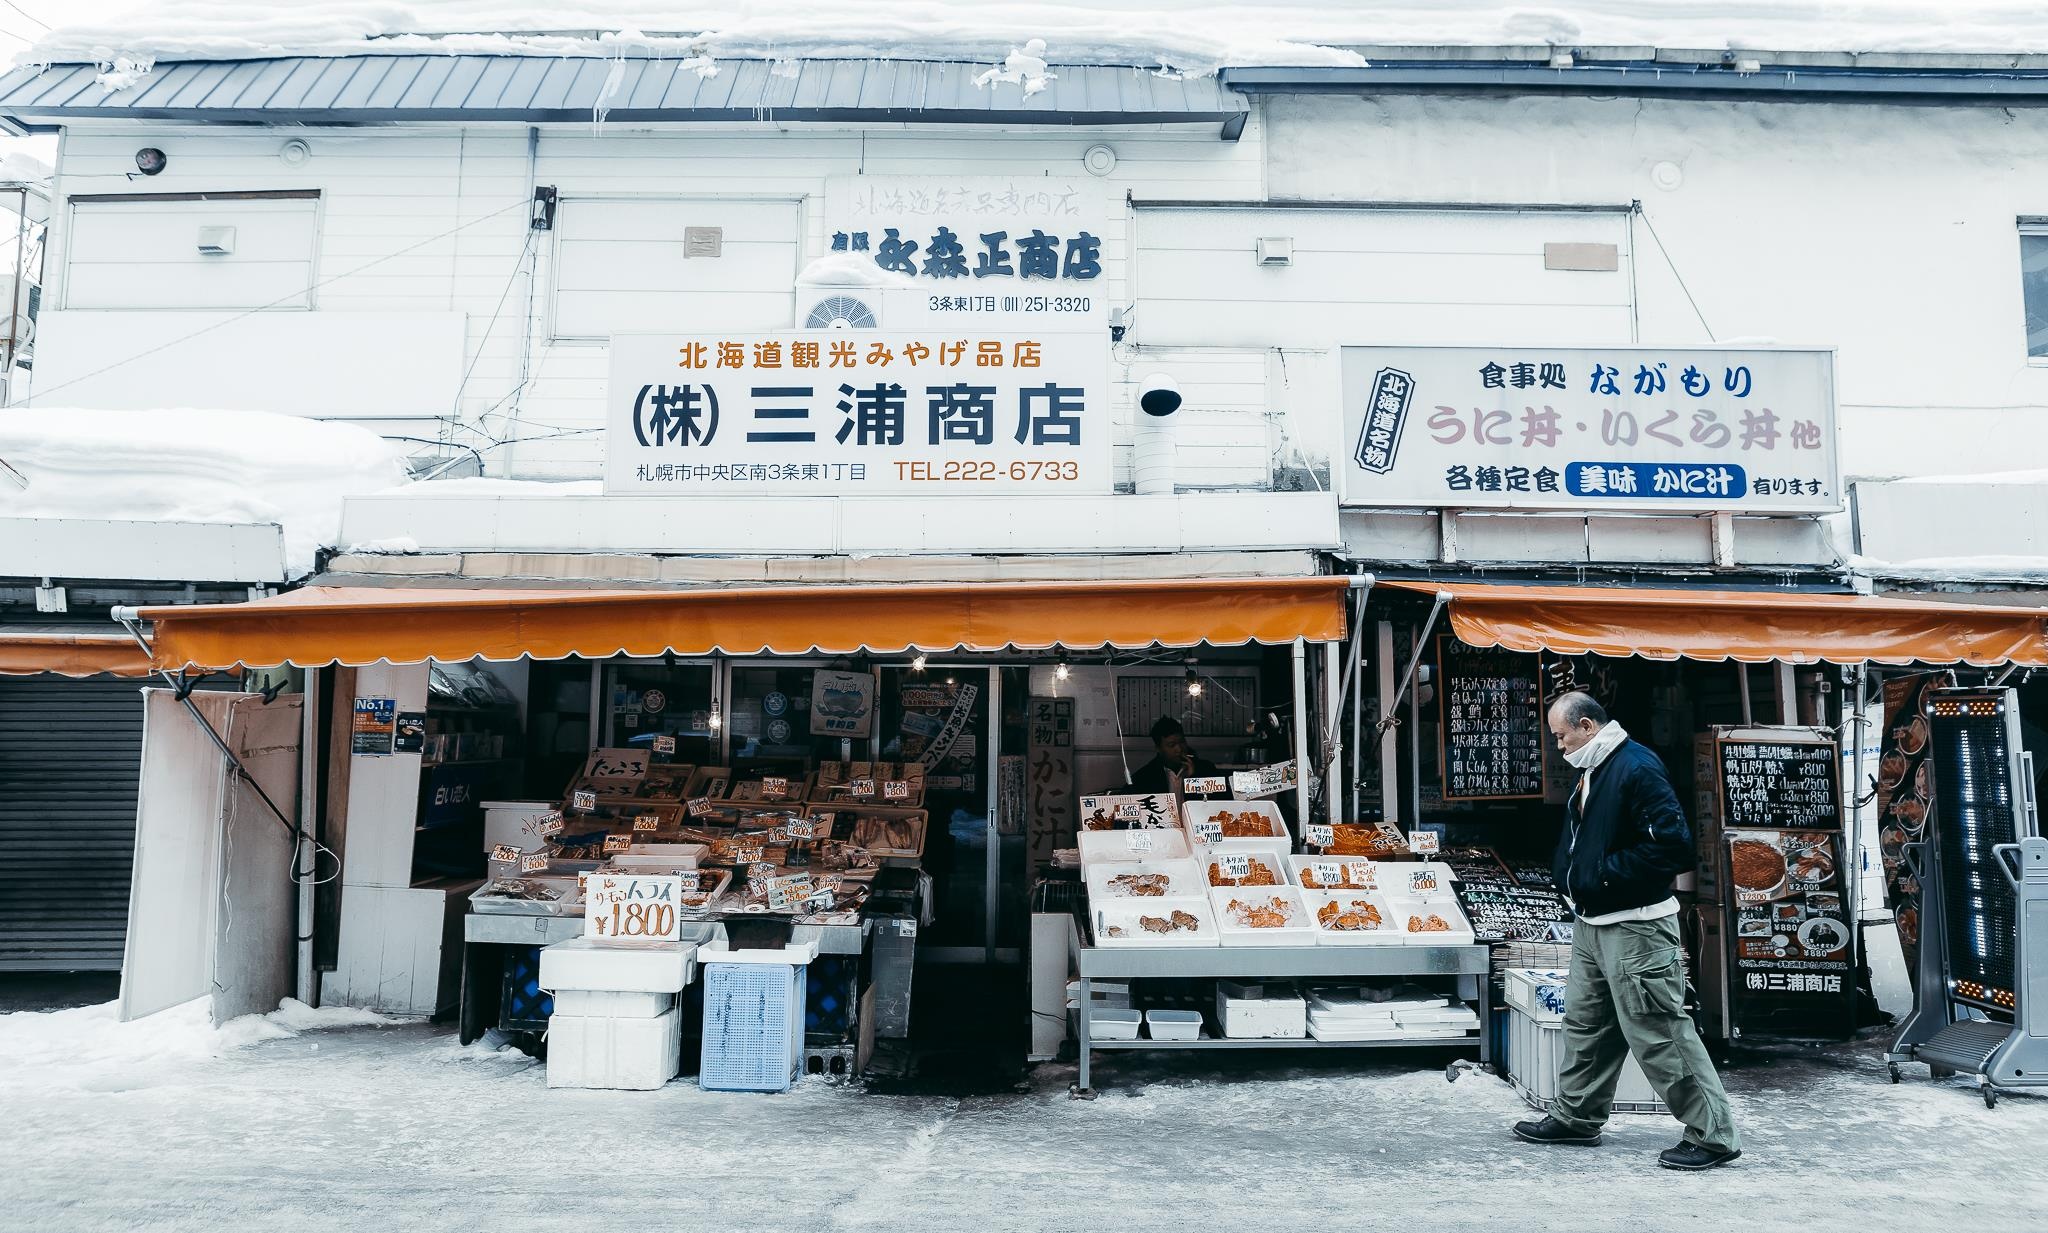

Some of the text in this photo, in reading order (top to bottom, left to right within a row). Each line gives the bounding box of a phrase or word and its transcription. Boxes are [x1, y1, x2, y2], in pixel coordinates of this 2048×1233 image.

[875, 226, 1102, 280] 永森正商店
[679, 340, 1043, 369] 北海道観光みやげ品店
[1479, 361, 1753, 398] 食事処 ながもり
[1363, 375, 1407, 467] 北海道名物
[636, 463, 866, 482] 札幌市中央区南3条東1丁目
[1446, 464, 1561, 494] 各種定食
[1579, 464, 1637, 494] 美味
[1653, 464, 1734, 496] かに汁
[356, 700, 384, 710] No.1
[1036, 704, 1054, 745] 名物
[1032, 750, 1069, 851] かに汁
[595, 903, 675, 937] ¥1,800
[1746, 972, 1842, 993] (株)三浦商店
